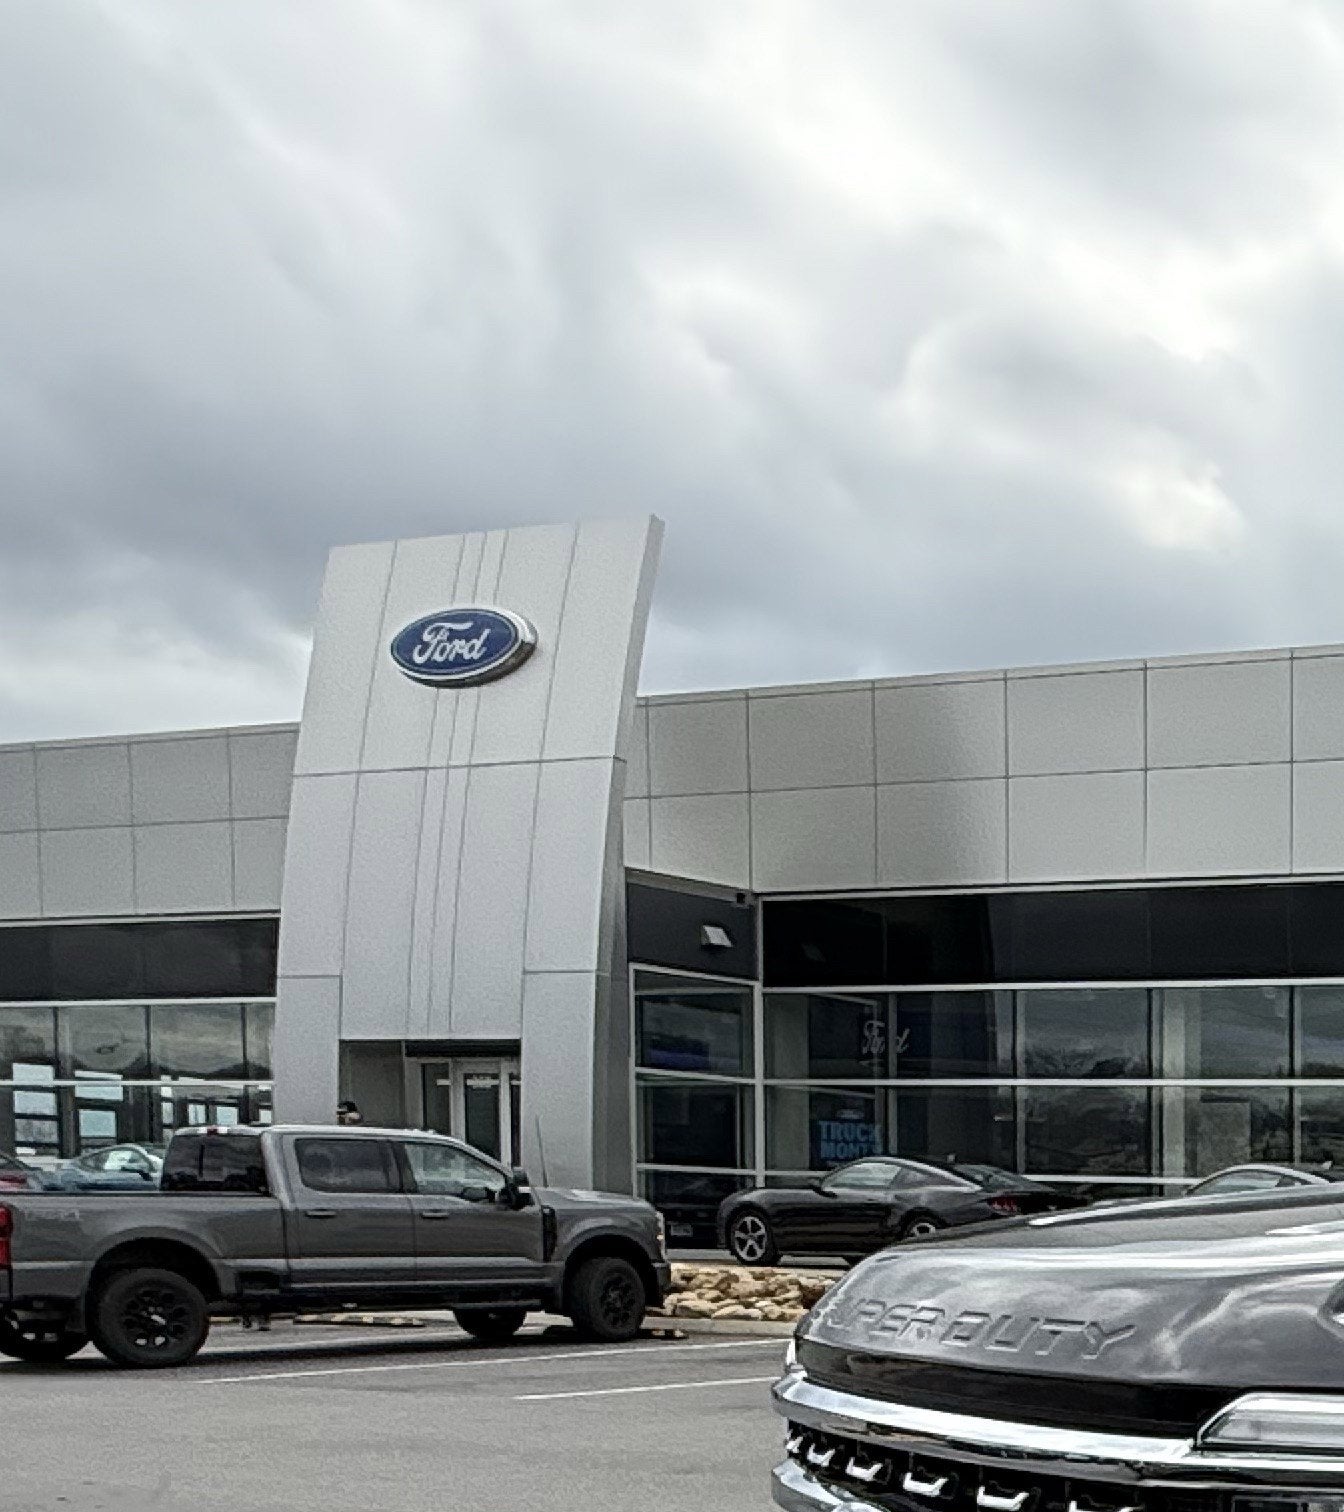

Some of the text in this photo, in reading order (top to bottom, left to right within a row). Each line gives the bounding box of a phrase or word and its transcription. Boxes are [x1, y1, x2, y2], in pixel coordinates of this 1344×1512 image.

[412, 622, 491, 664] Ford
[862, 1020, 910, 1054] Fod
[939, 1310, 1136, 1360] DUTY
